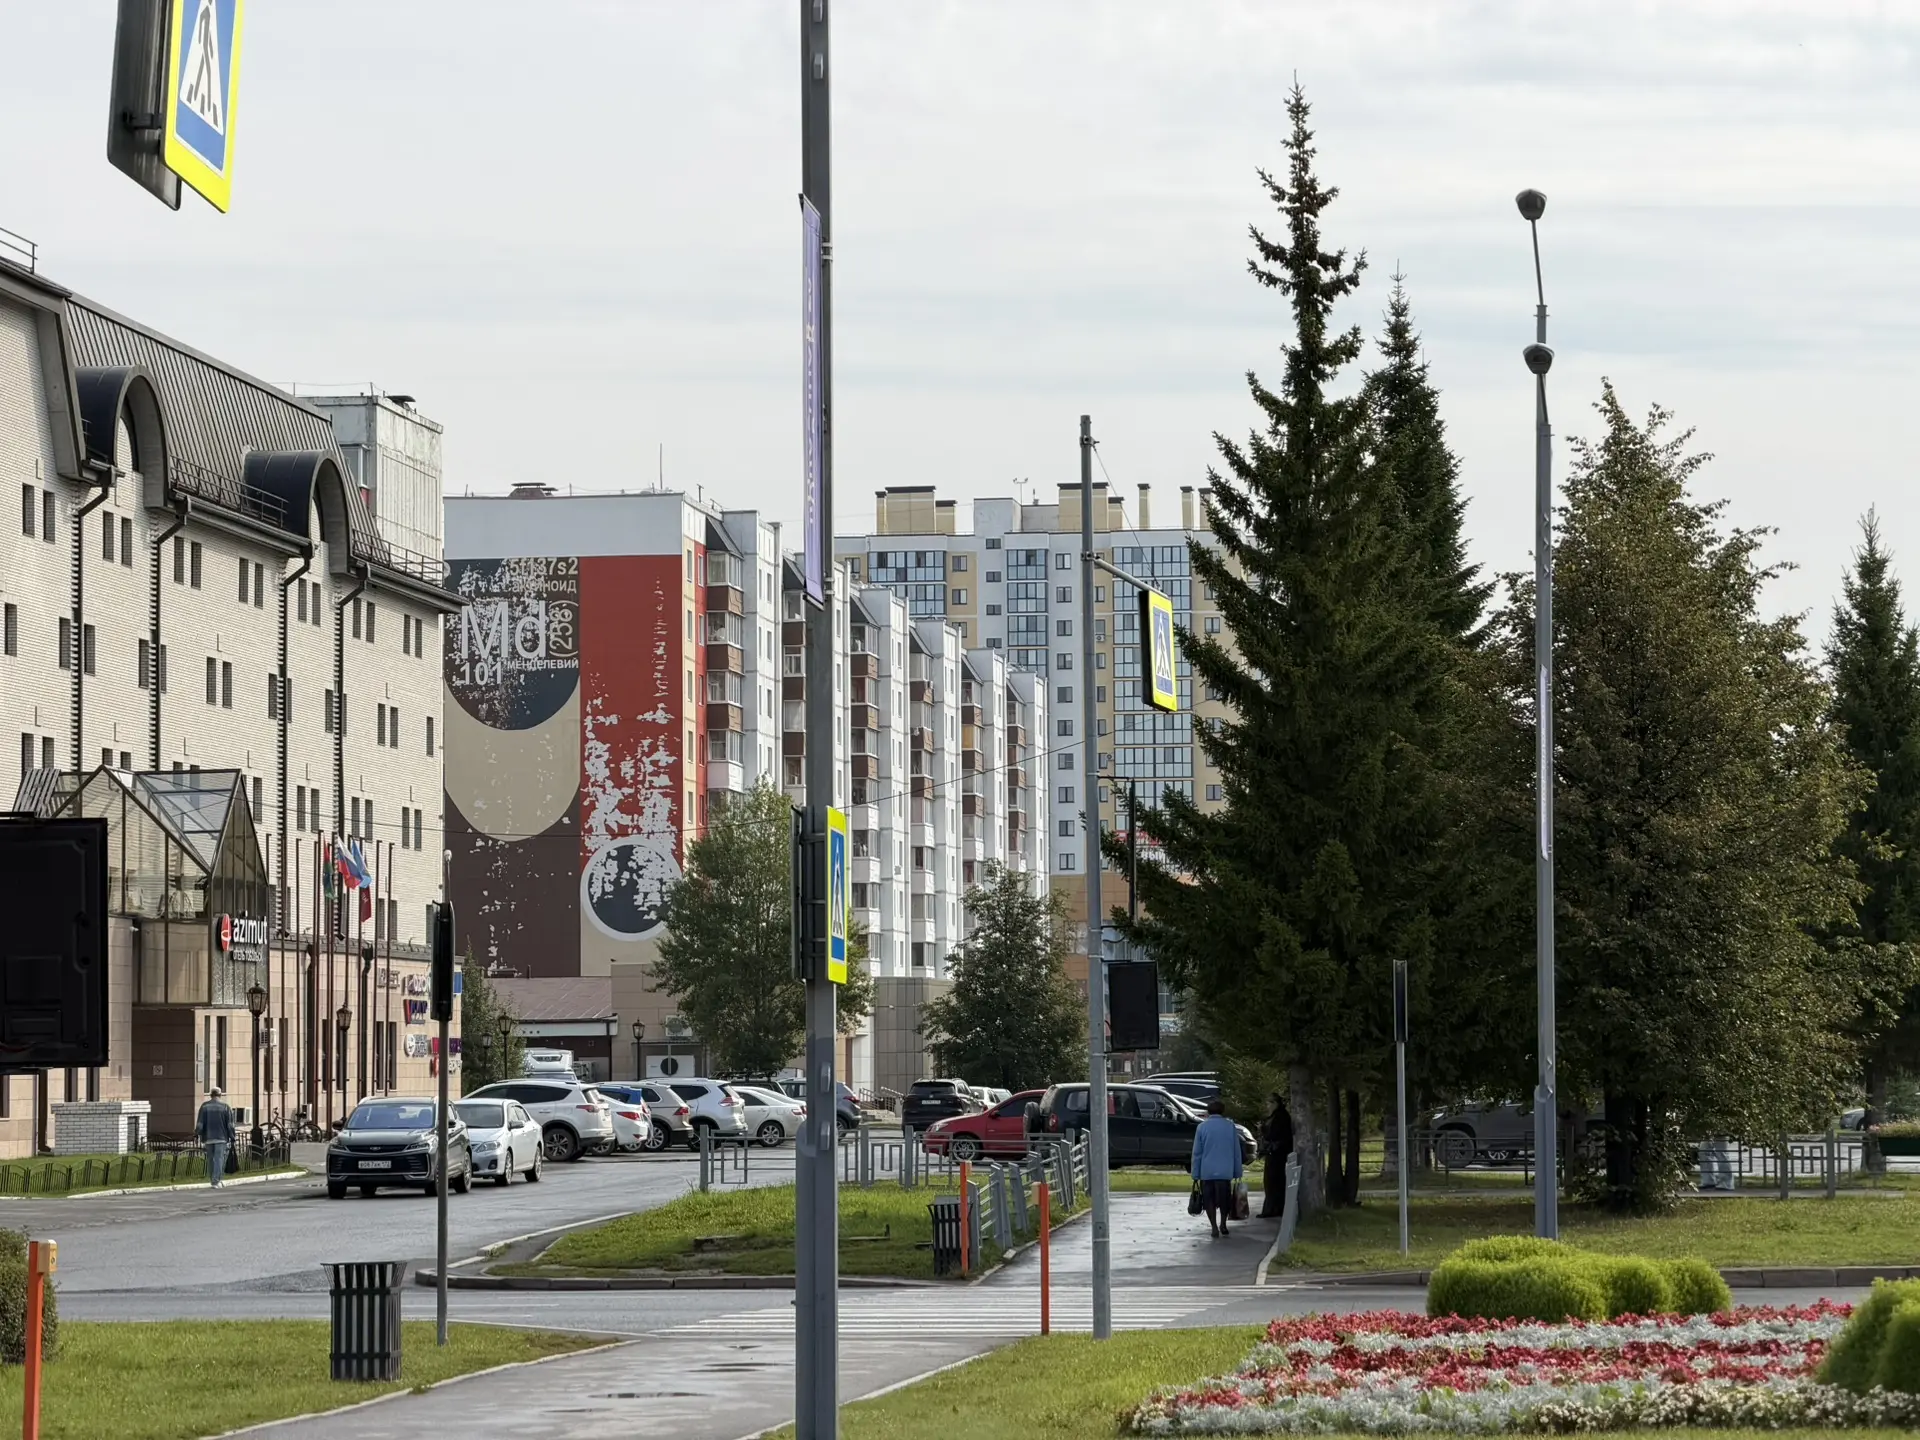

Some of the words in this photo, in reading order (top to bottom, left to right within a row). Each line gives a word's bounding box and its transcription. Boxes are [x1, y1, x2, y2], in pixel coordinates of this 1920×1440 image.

[460, 600, 548, 659] Md
[549, 599, 579, 658] (258)
[459, 662, 503, 686] 101
[233, 910, 268, 945] azimut
